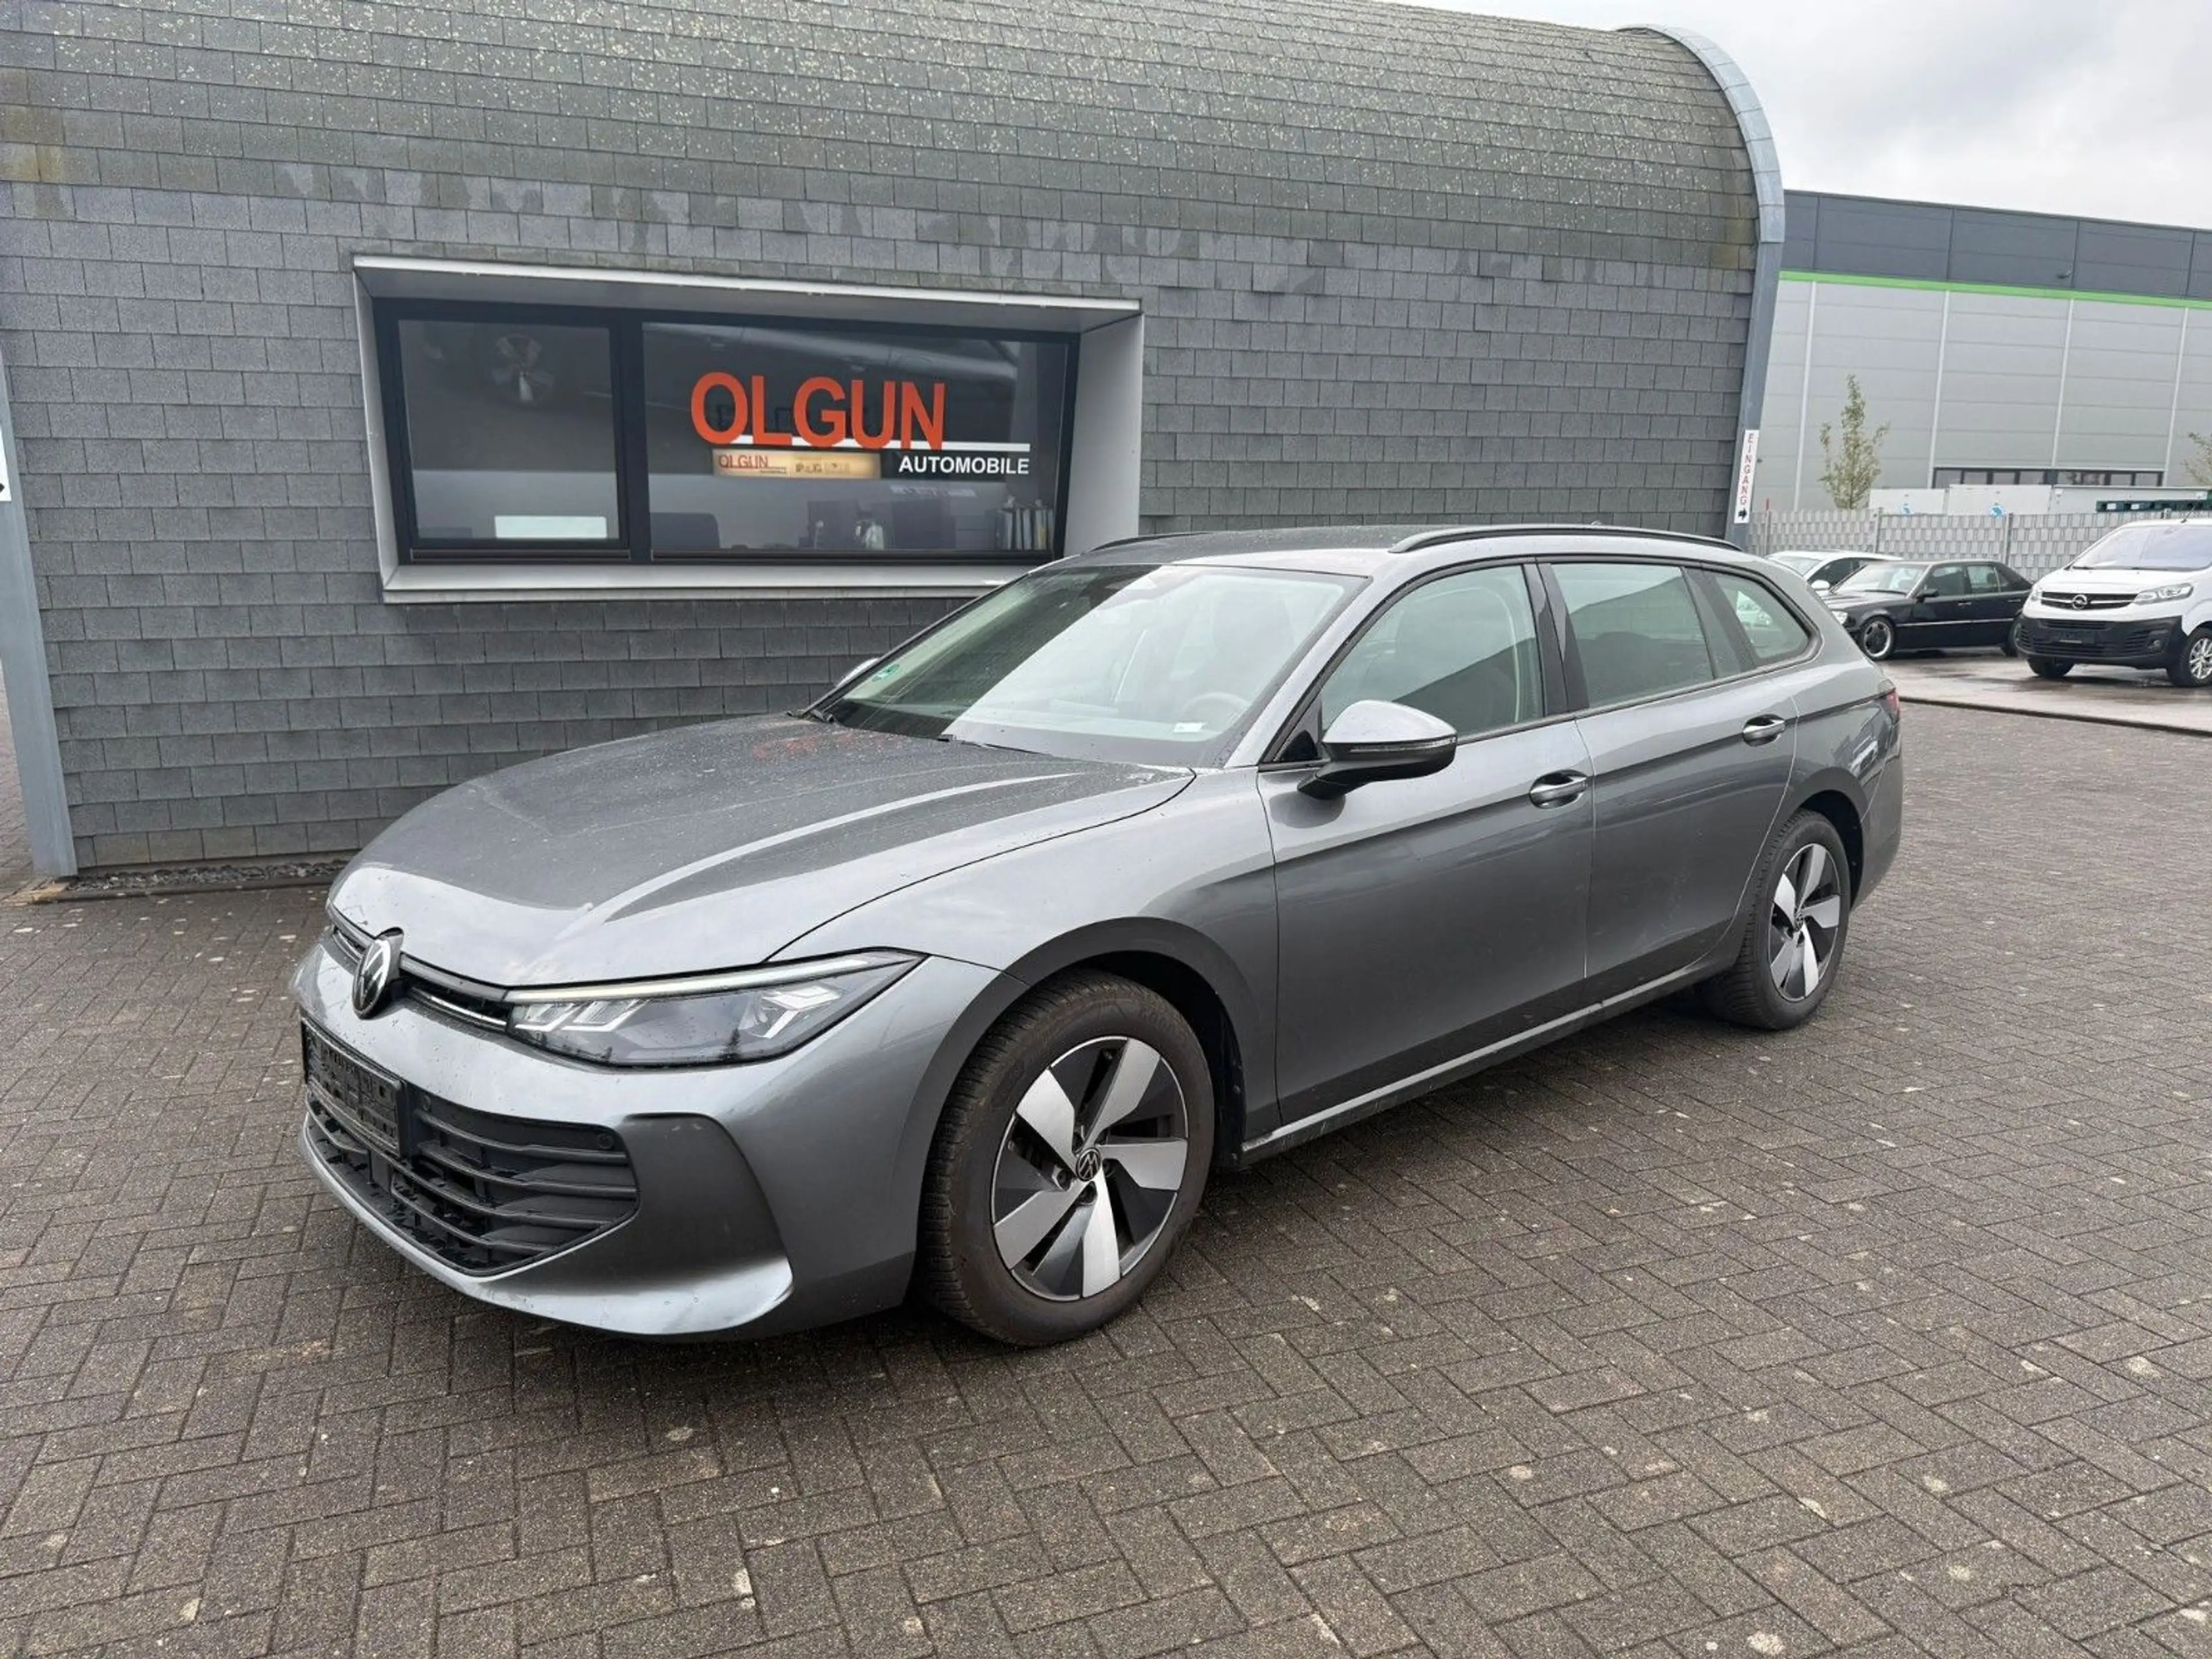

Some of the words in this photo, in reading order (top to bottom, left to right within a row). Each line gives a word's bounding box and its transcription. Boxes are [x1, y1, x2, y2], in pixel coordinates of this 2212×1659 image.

[691, 372, 945, 449] OLGUN
[718, 454, 768, 469] OLGUN
[899, 456, 1030, 475] AUTOMOBILE
[1740, 433, 1754, 505] EINGANG
